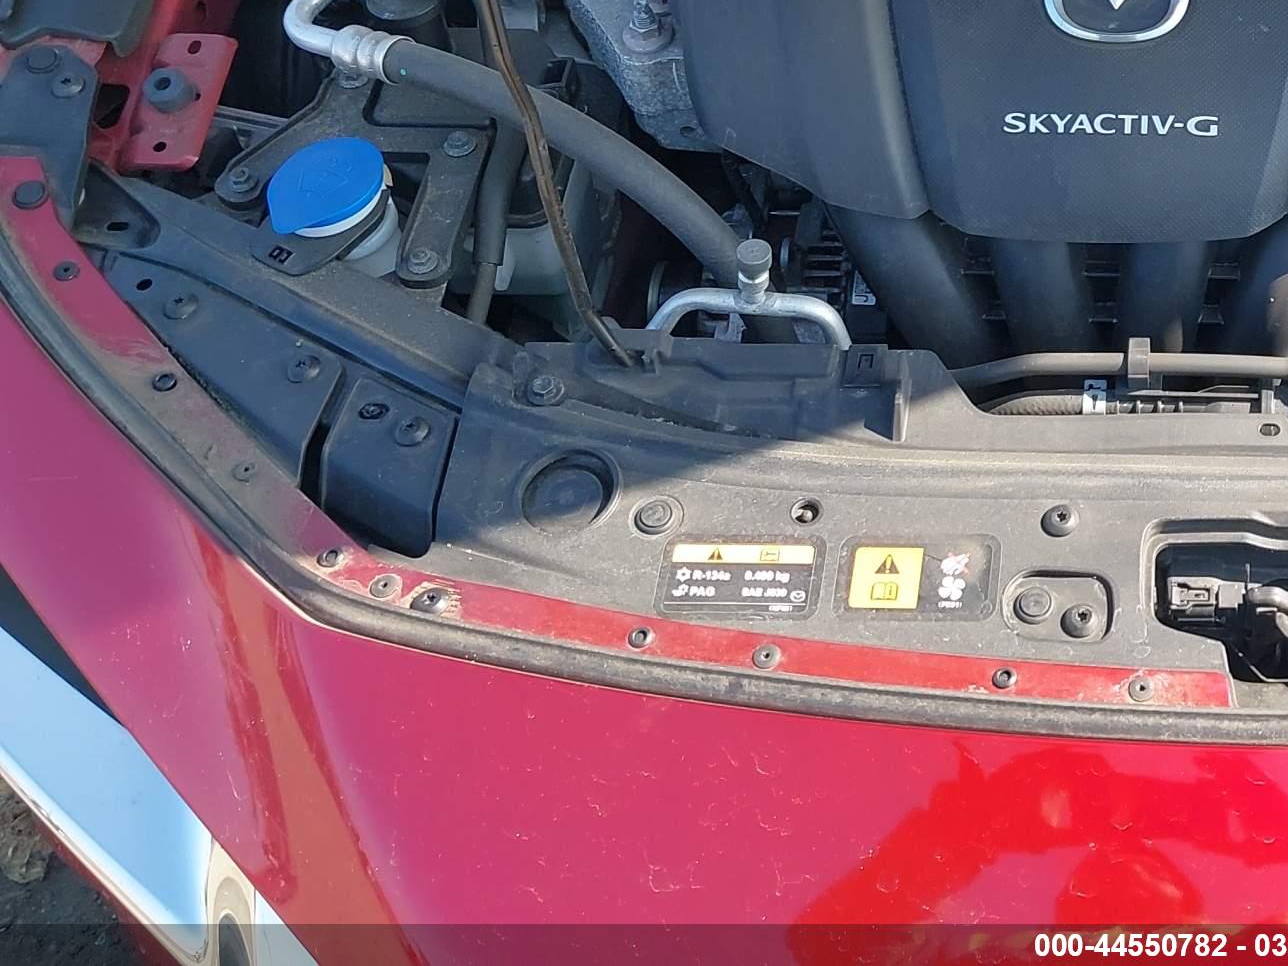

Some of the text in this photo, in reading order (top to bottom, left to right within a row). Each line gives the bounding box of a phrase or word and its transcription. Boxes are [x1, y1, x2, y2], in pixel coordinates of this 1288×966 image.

[1003, 112, 1219, 137] SKYACTIV-G
[692, 569, 731, 581] R-134a
[689, 586, 716, 597] PAG
